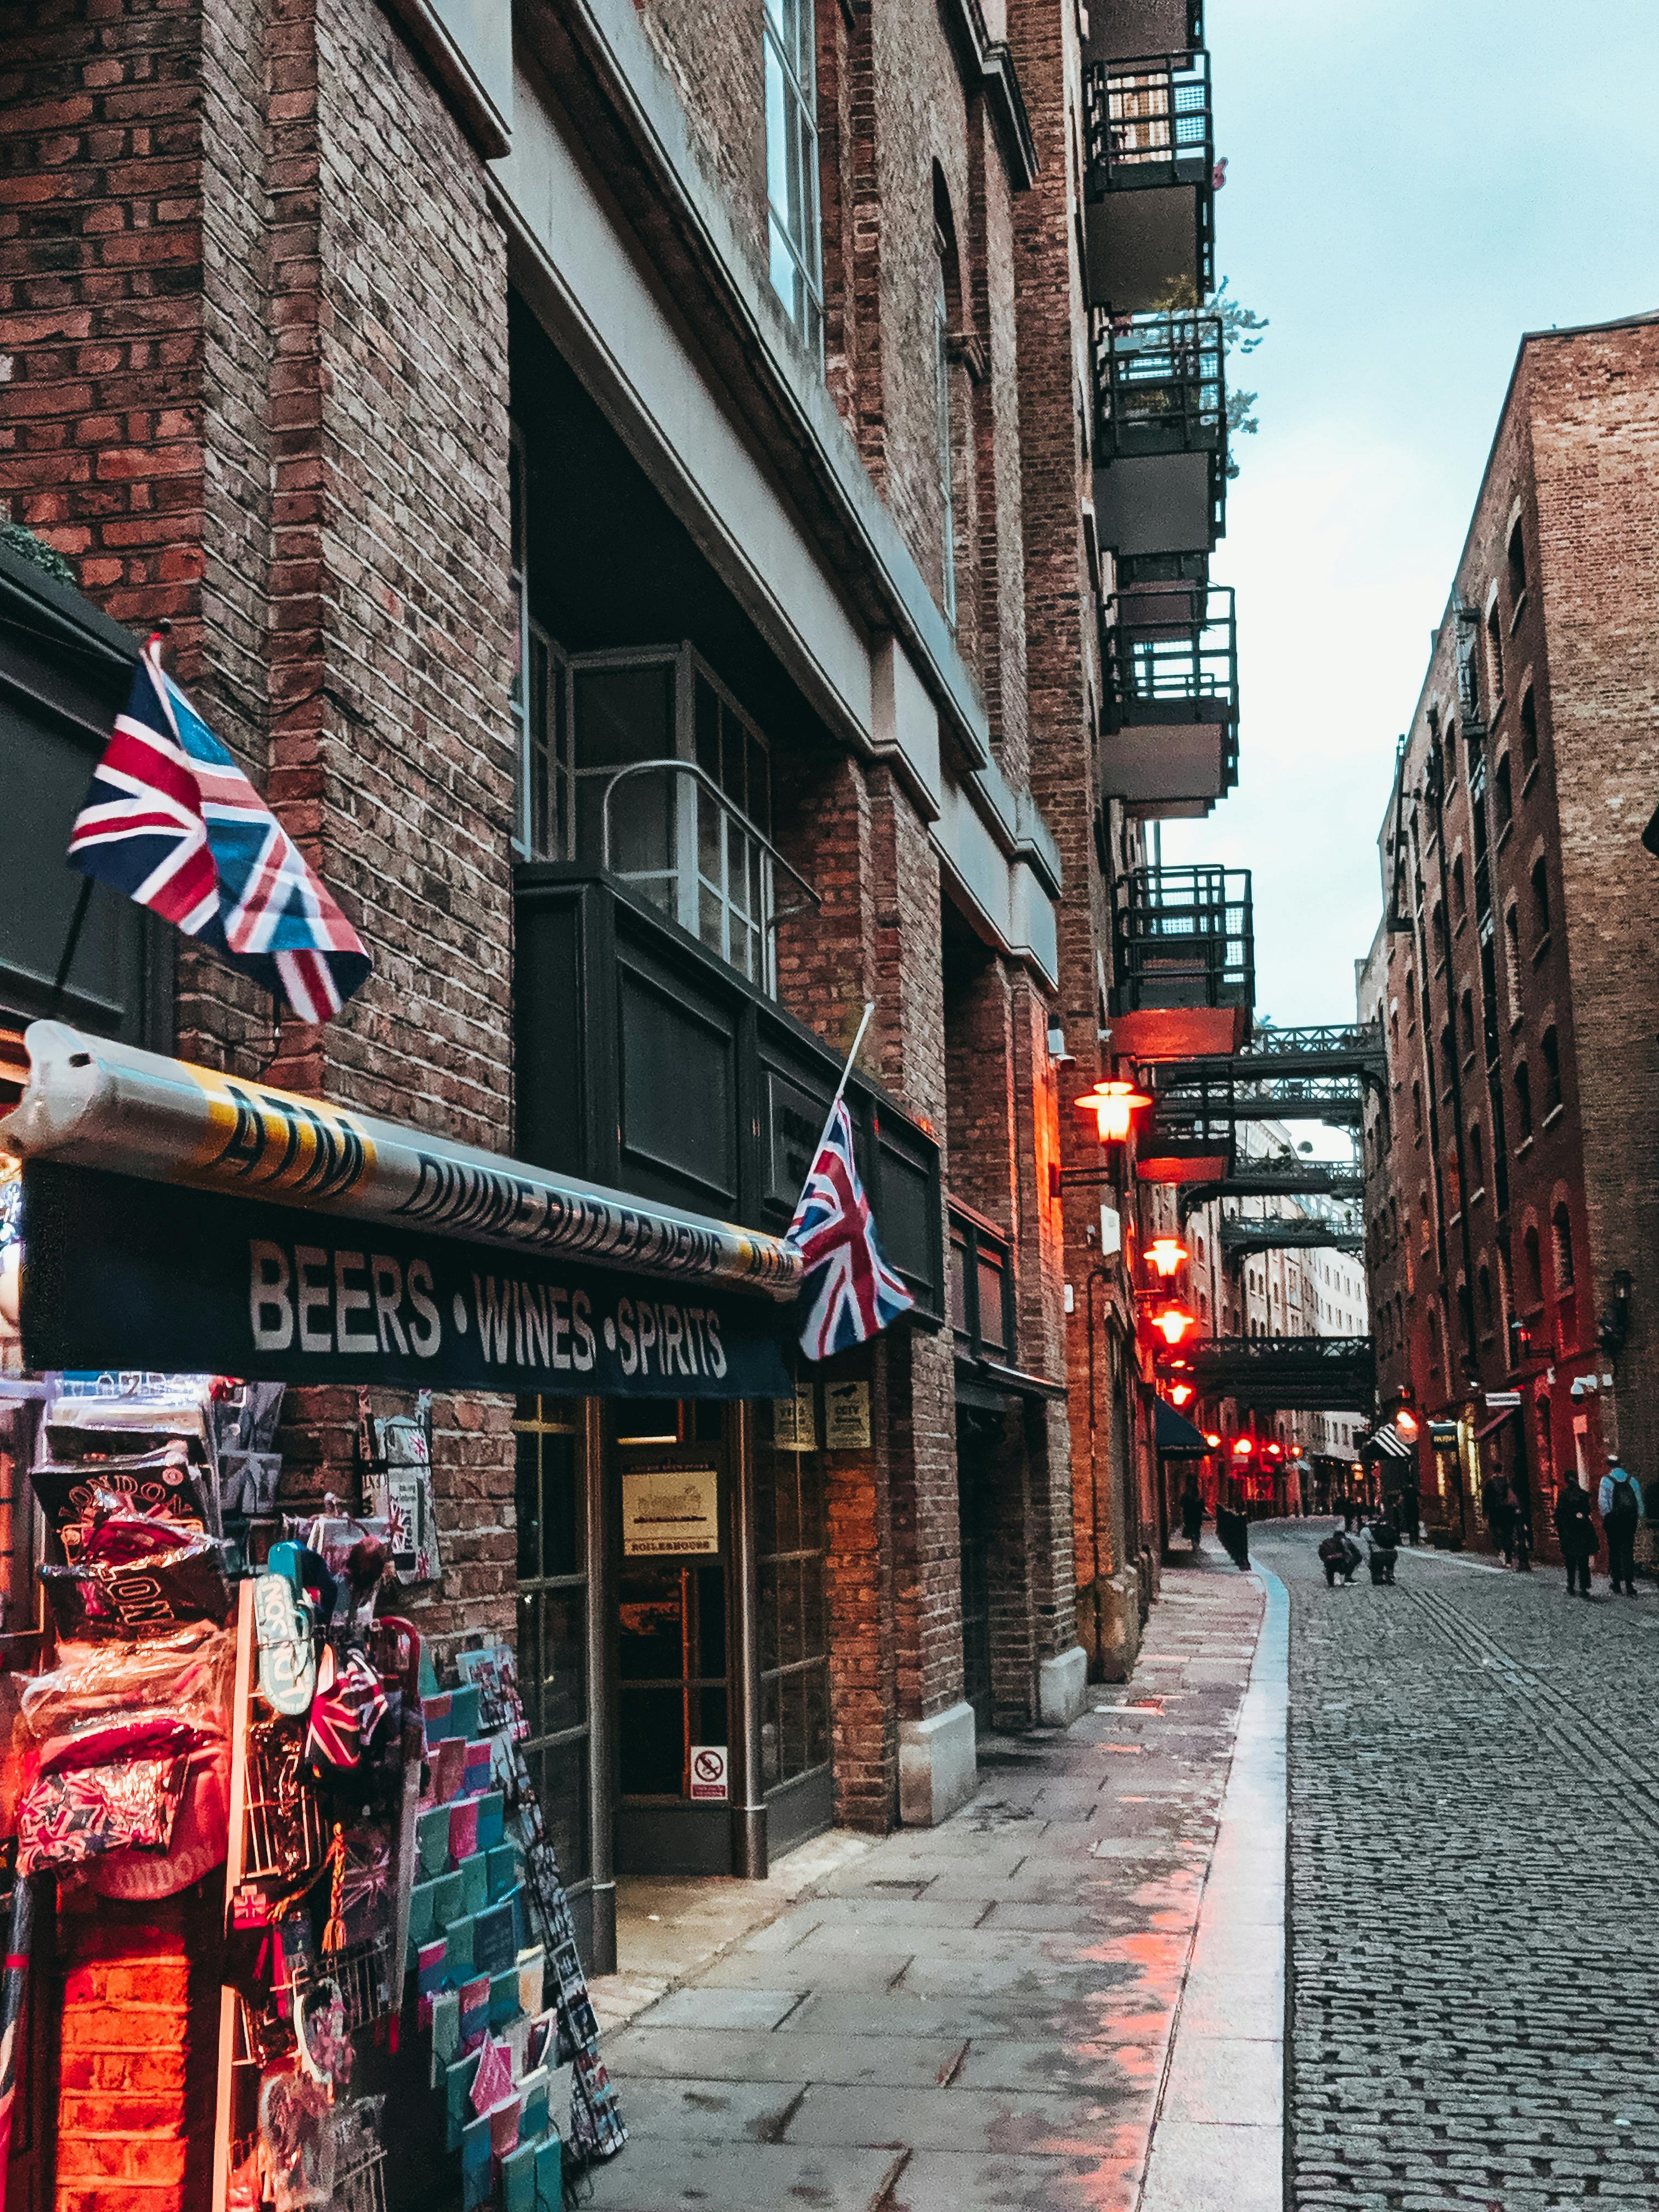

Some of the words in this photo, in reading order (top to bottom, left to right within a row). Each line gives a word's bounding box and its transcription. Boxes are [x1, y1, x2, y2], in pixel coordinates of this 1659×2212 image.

[206, 1084, 366, 1196] ATM
[390, 1153, 535, 1235] DIVINE
[527, 1189, 653, 1262] BUTLER
[650, 1224, 723, 1276] NEWS
[250, 1238, 441, 1358] BEERS
[471, 1272, 596, 1372] WINES
[617, 1297, 727, 1379] SPIRITS
[58, 1475, 193, 1519] ONDON
[113, 1839, 215, 1893] ONDON
